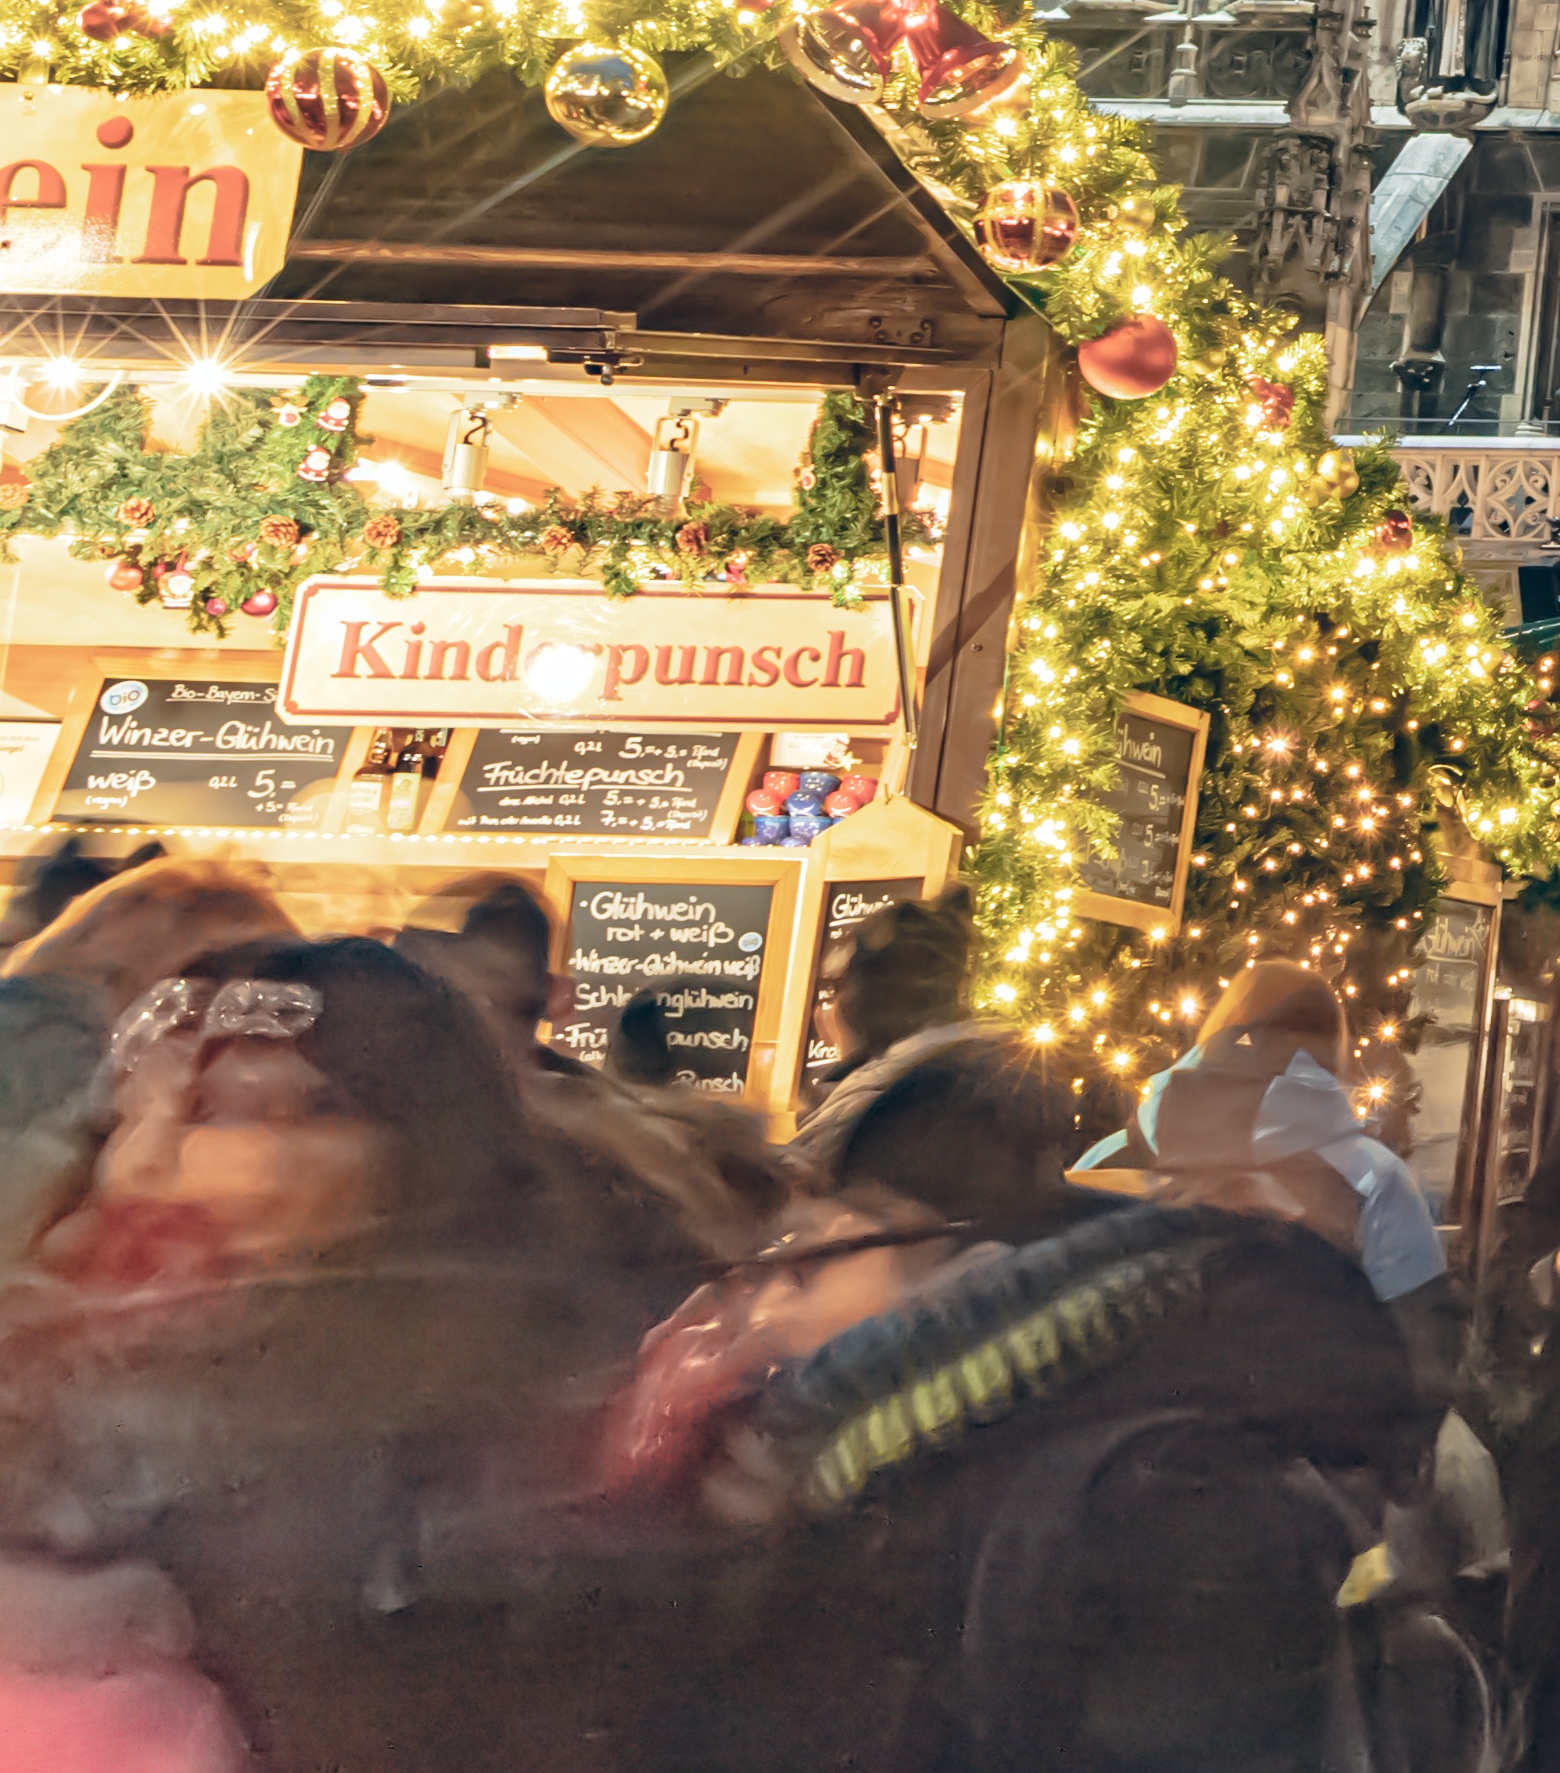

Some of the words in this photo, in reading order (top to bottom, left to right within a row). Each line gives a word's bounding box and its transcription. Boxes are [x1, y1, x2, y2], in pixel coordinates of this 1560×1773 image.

[330, 620, 867, 701] Kindpunsch
[99, 714, 335, 755] Winzer-Glühwein
[87, 769, 156, 798] weiß
[483, 760, 685, 792] Früchtepunsch
[590, 891, 717, 923] Glühwein
[606, 924, 645, 942] rot
[670, 922, 736, 947] weiß
[565, 1022, 749, 1052] Früpunsch
